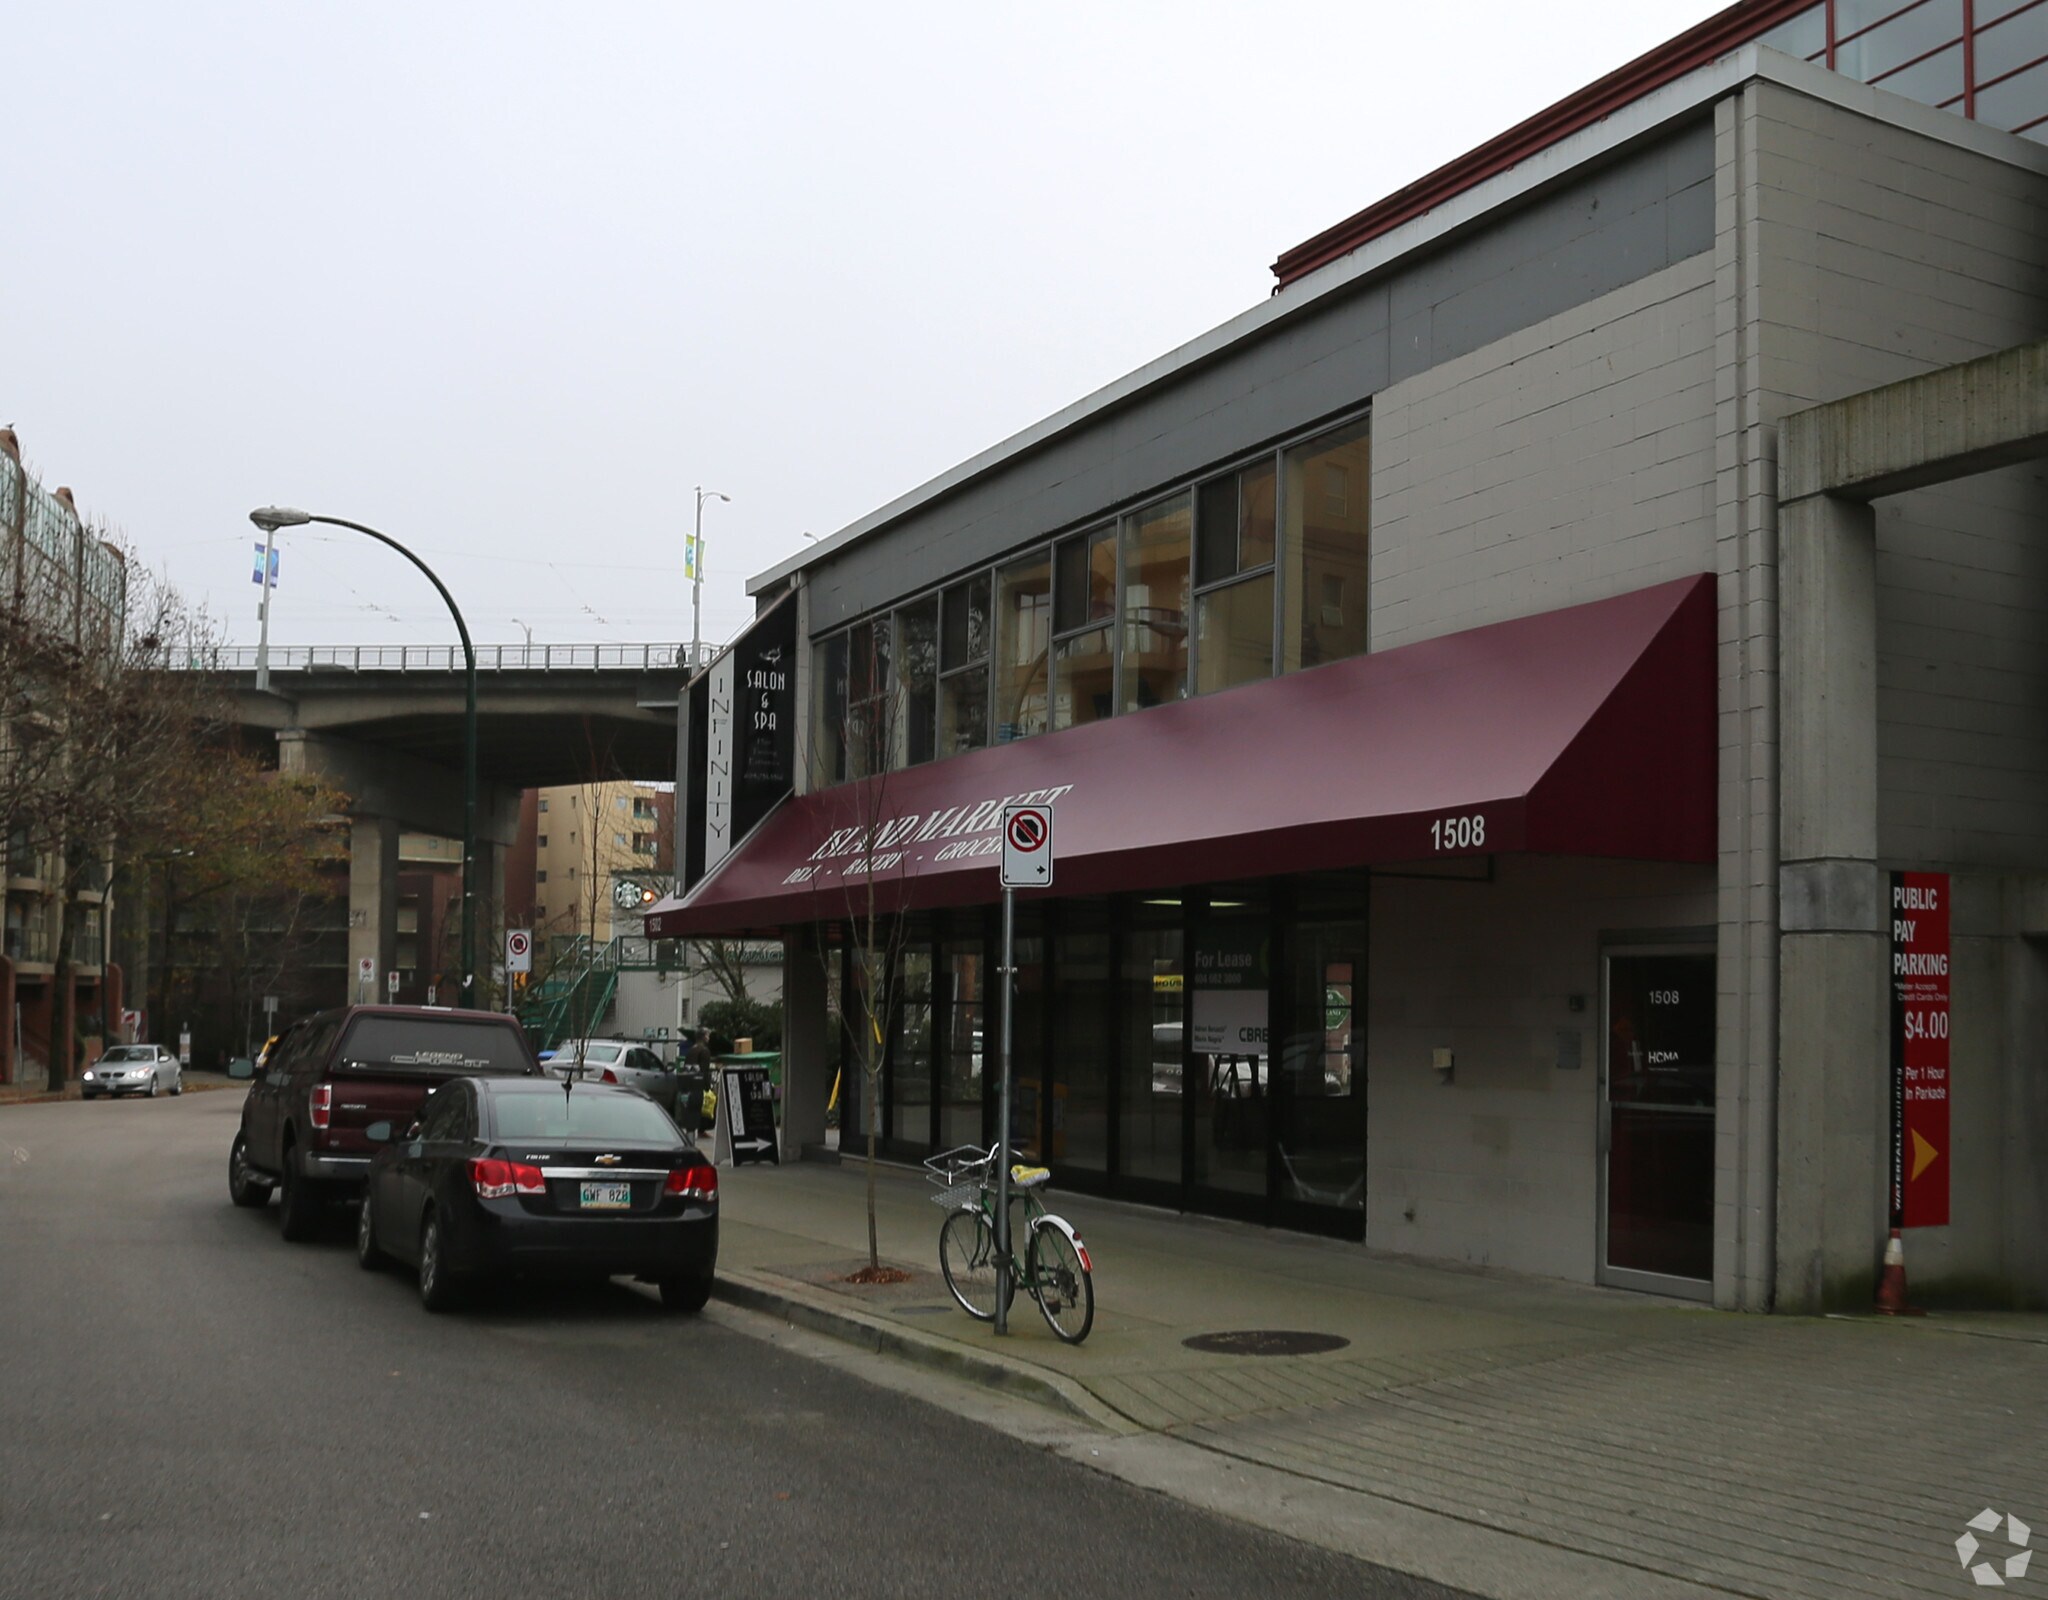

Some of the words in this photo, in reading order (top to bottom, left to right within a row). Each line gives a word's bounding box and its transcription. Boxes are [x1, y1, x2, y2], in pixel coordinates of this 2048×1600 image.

[747, 669, 785, 691] SALON
[761, 691, 769, 709] &
[754, 711, 776, 731] SPA
[709, 677, 729, 838] INFINITY
[807, 814, 920, 862] ISLAND
[1431, 814, 1485, 851] 1508
[1893, 886, 1938, 910] PUBLIC
[1893, 919, 1916, 942] PAY
[1195, 950, 1214, 968] For
[1217, 949, 1252, 967] Lease
[1893, 953, 1948, 976] PARKING
[1648, 990, 1680, 1005] 1508
[1238, 1027, 1268, 1042] CBRE
[1905, 1010, 1948, 1043] $4.00
[1905, 1066, 1918, 1080] Per
[1926, 1066, 1945, 1080] Hour
[1905, 1086, 1913, 1100] In
[1915, 1086, 1946, 1100] Parkade
[583, 1189, 602, 1202] GWF
